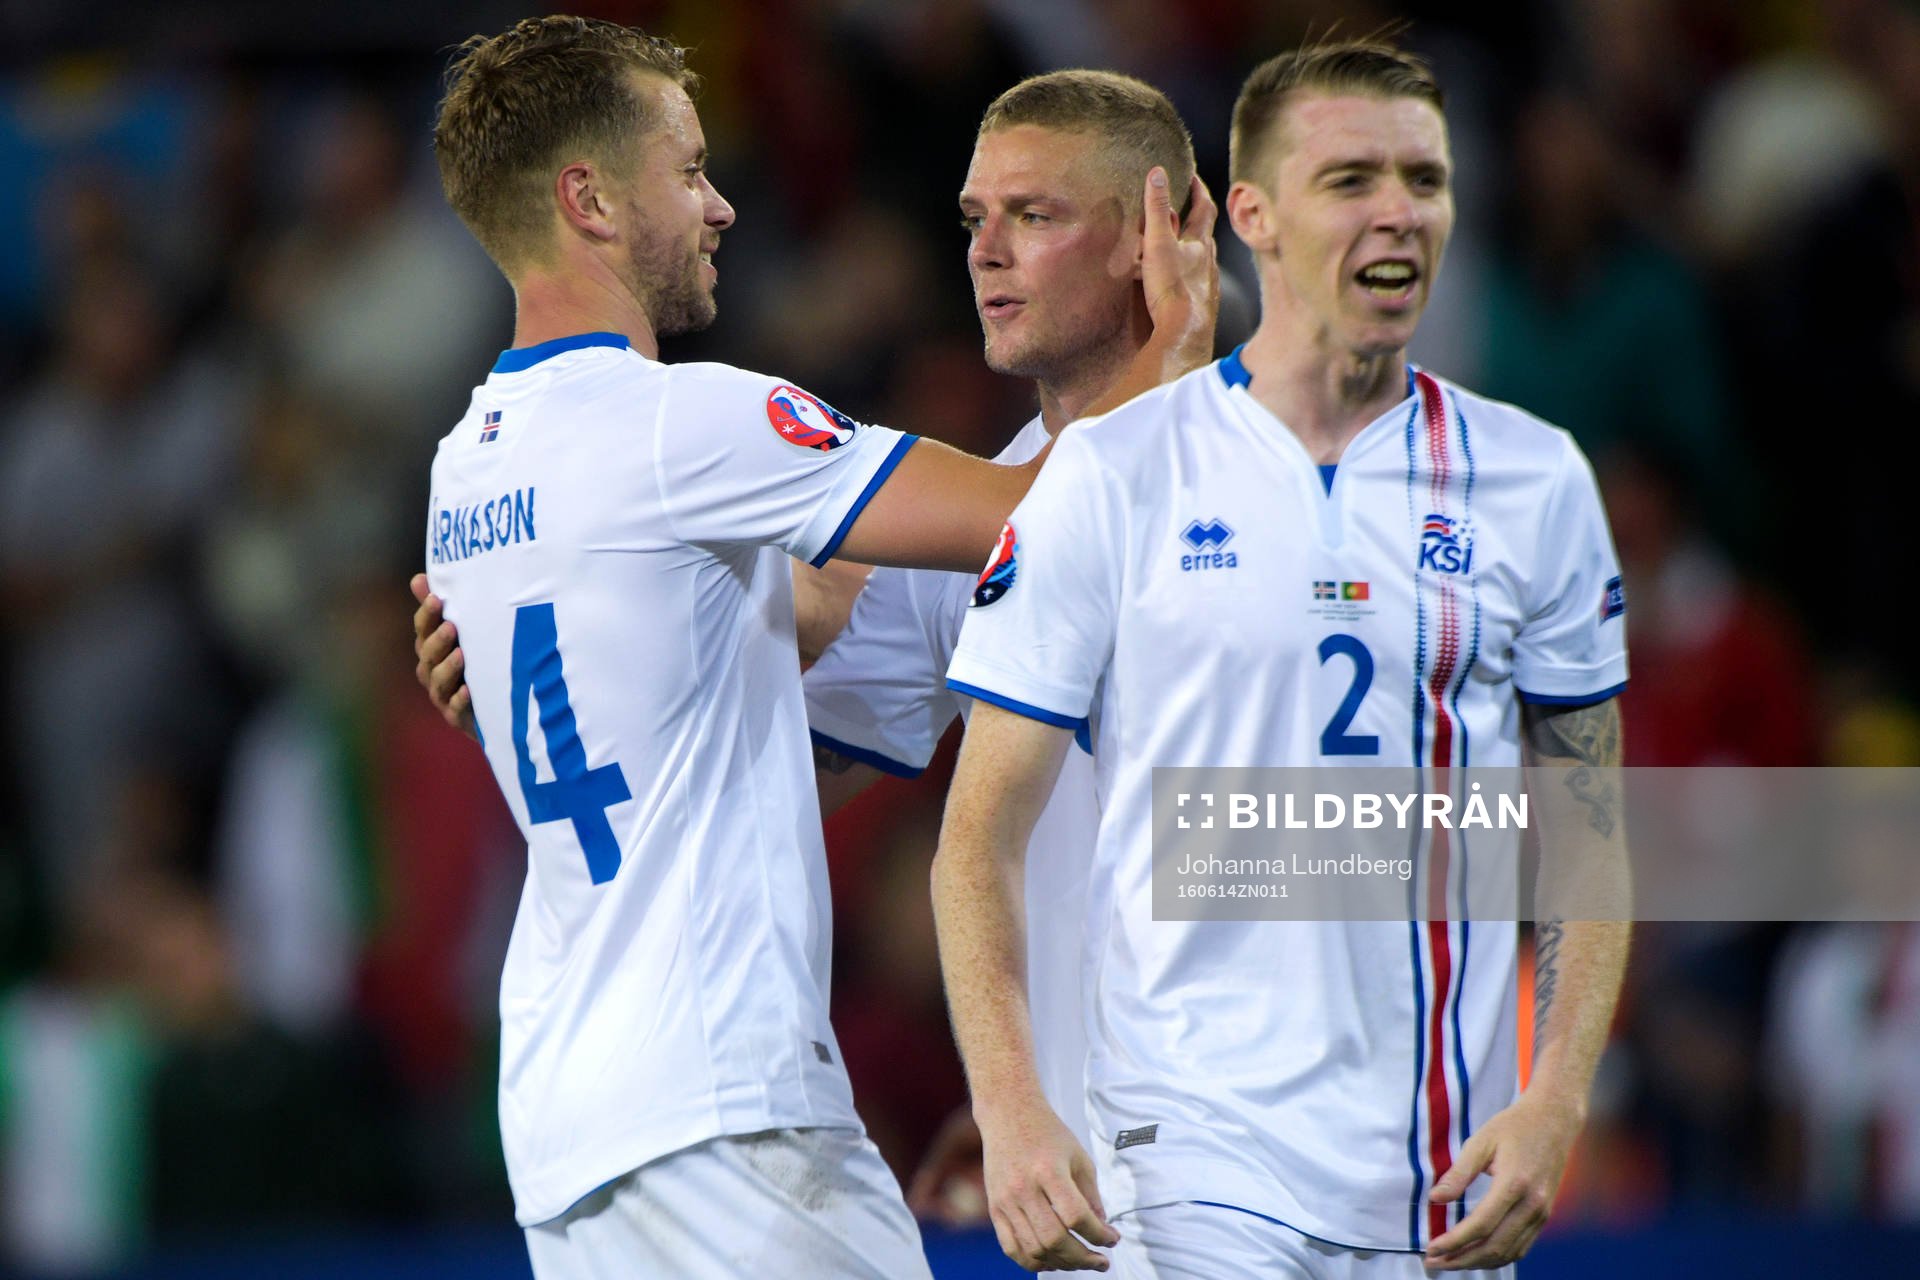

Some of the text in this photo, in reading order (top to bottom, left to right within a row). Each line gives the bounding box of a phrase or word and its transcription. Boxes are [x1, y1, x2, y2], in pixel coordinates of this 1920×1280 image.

[1181, 552, 1237, 571] errea
[473, 602, 632, 886] 4
[1317, 634, 1379, 755] 2
